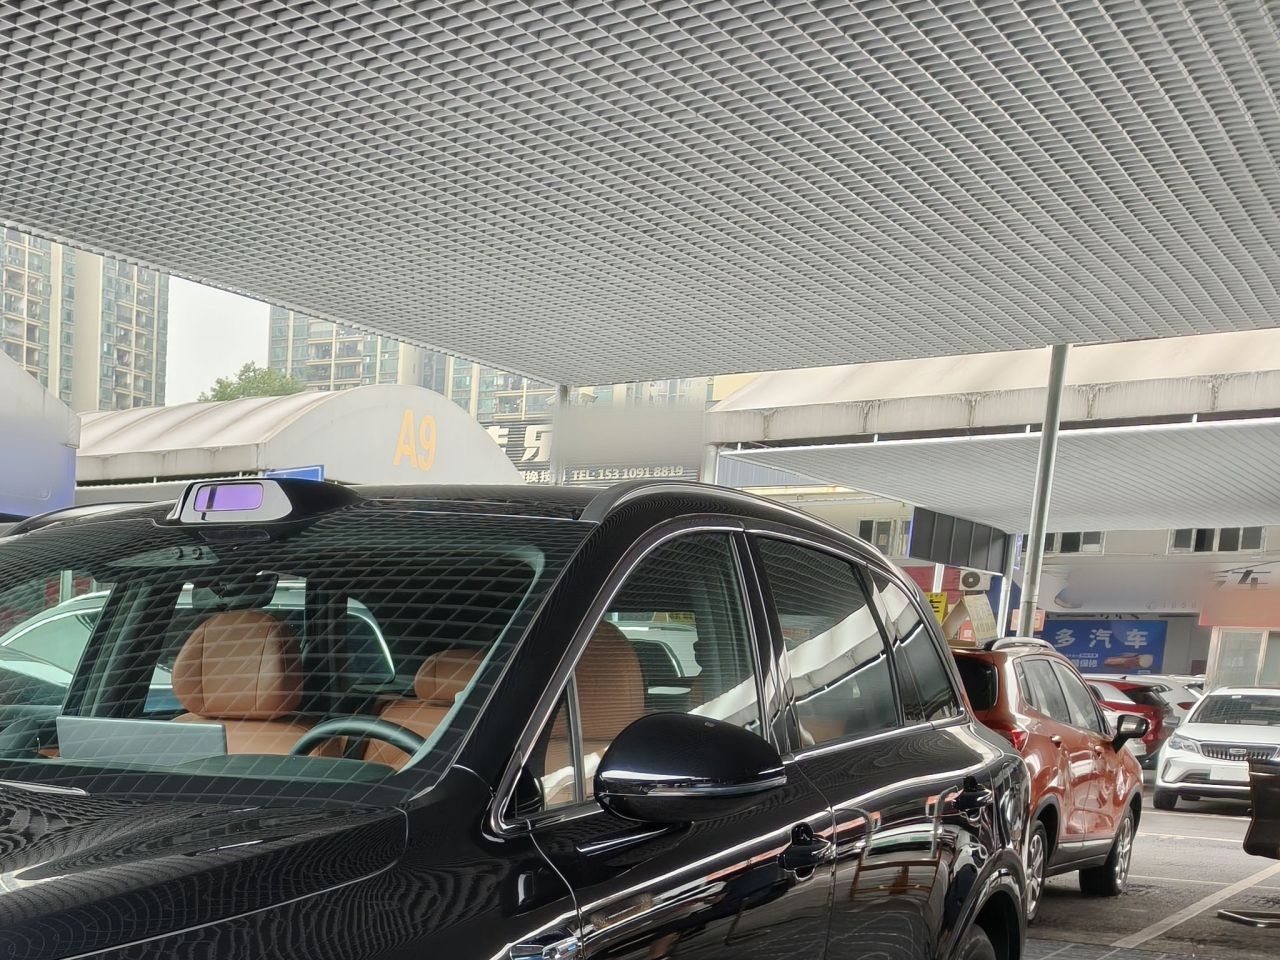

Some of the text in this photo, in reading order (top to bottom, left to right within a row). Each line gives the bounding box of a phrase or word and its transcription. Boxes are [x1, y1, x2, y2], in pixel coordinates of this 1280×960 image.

[392, 408, 437, 471] A9
[598, 468, 620, 480] 153
[622, 466, 652, 479] 1091
[654, 464, 684, 477] 8819
